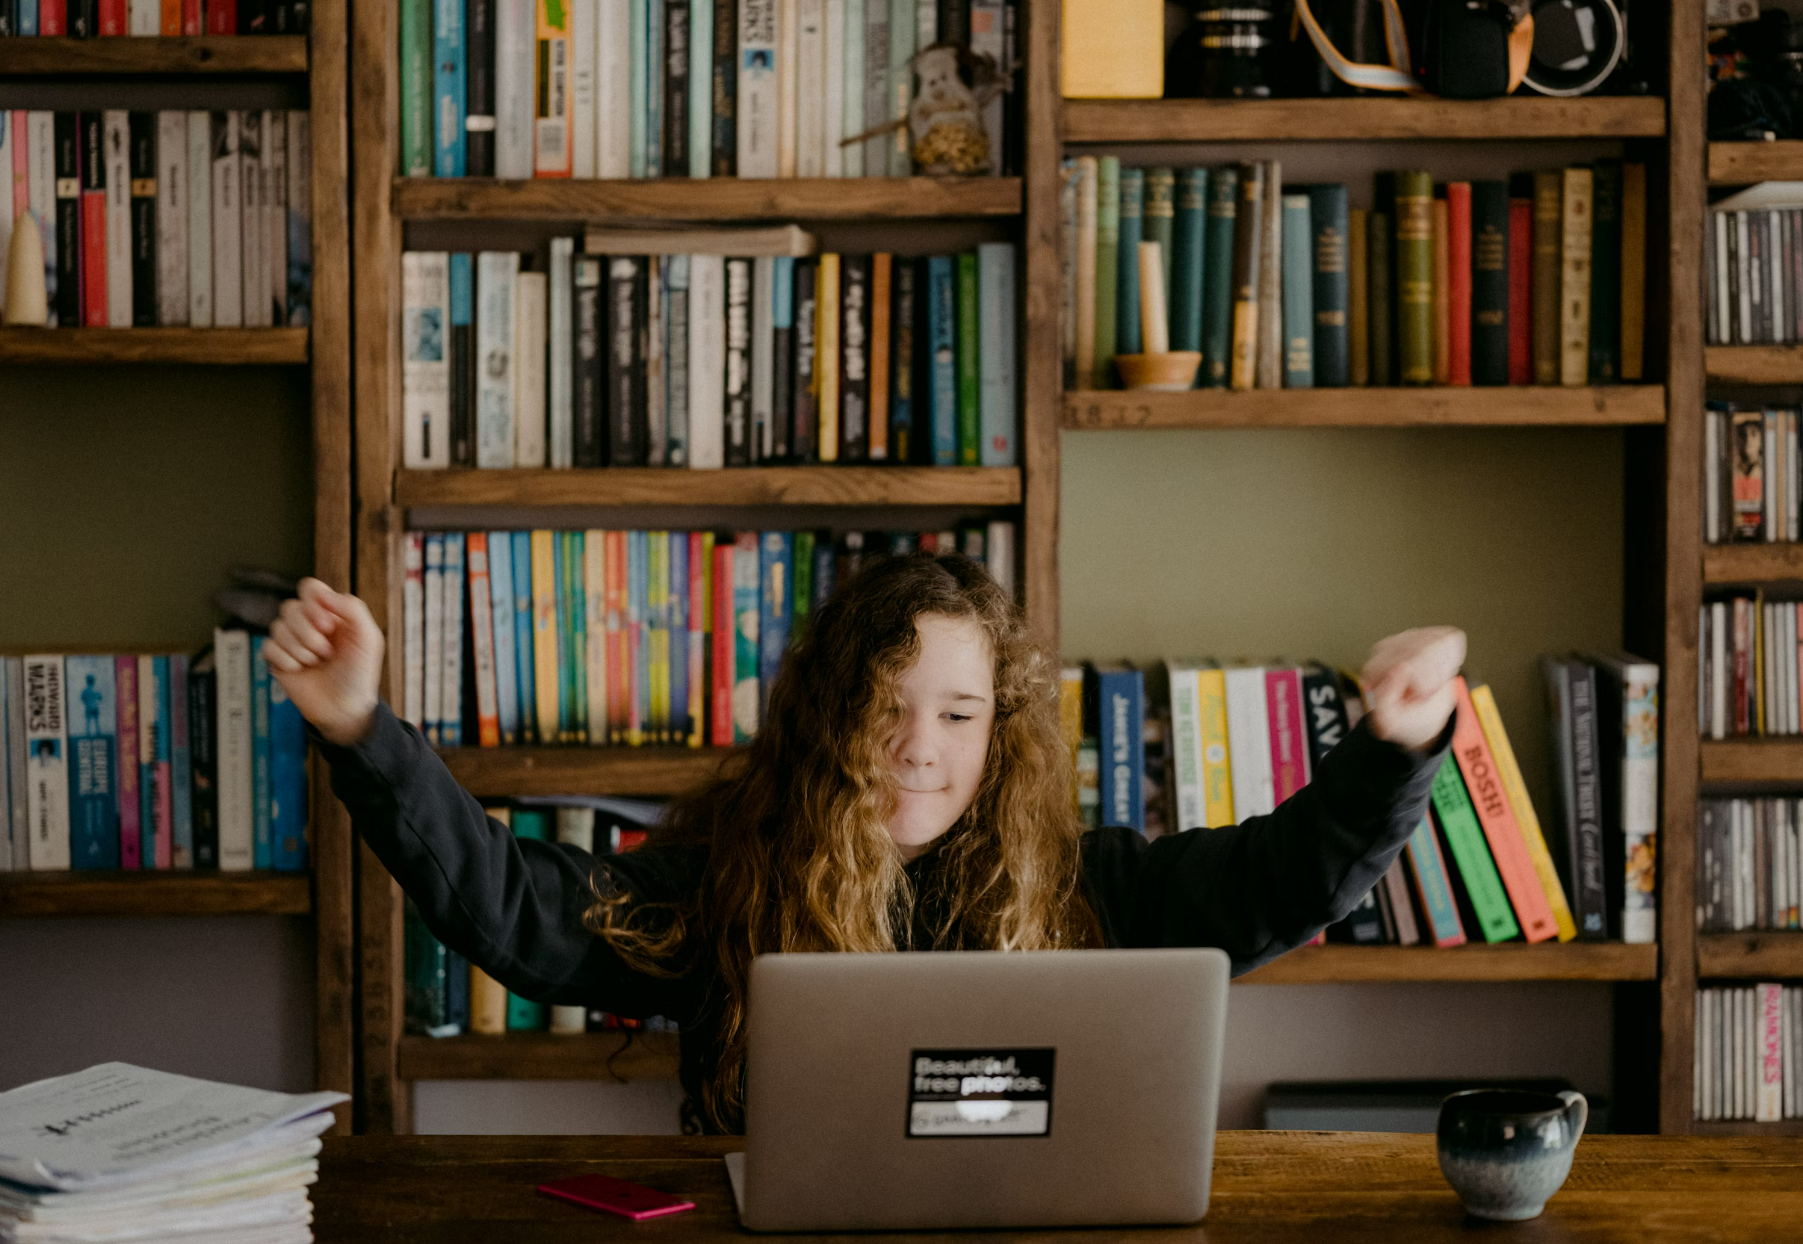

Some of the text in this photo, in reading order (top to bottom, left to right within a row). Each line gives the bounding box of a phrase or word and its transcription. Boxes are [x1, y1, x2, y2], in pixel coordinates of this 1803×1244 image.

[1113, 692, 1131, 763] JAMIE'S
[1308, 684, 1343, 758] SAV
[1464, 744, 1504, 818] BOSH!
[915, 1056, 1020, 1076] Beautiful,
[915, 1076, 1045, 1097] free photos.
